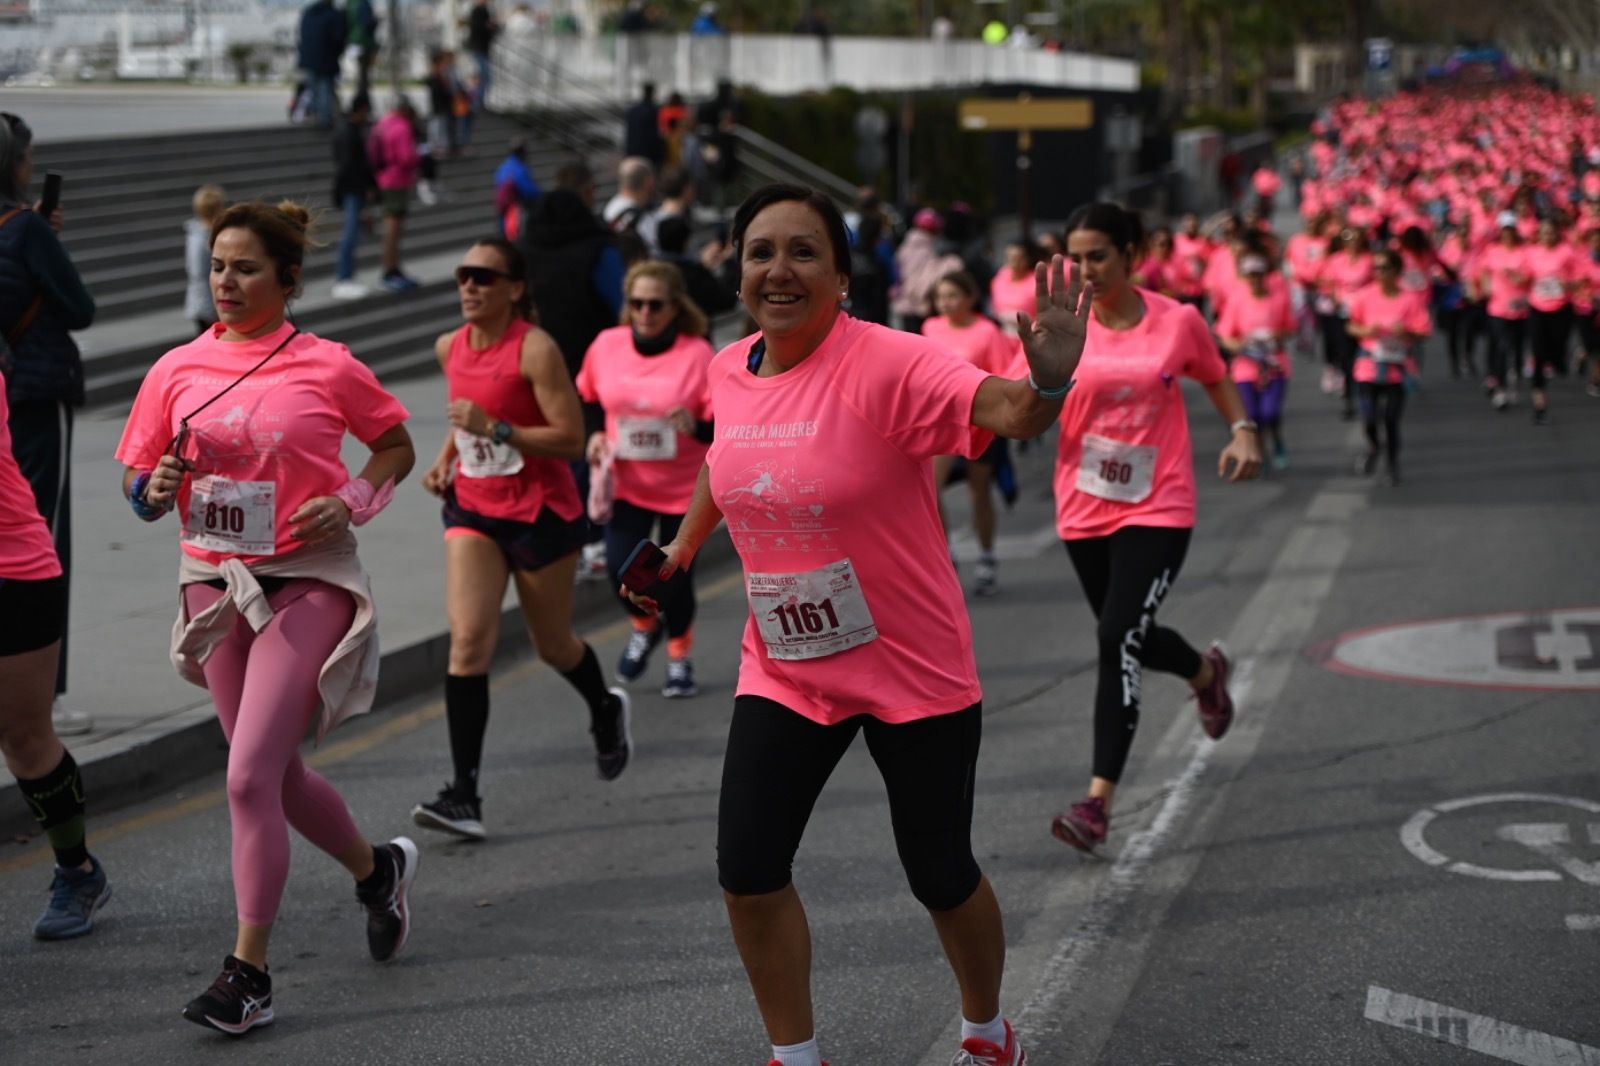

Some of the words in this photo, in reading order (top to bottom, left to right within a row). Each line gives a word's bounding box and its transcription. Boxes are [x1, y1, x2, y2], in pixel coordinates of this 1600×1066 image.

[720, 424, 766, 440] CARRERA
[768, 420, 818, 438] MUJERES
[1099, 459, 1132, 484] 160
[205, 501, 245, 534] 810
[774, 598, 840, 636] 1161
